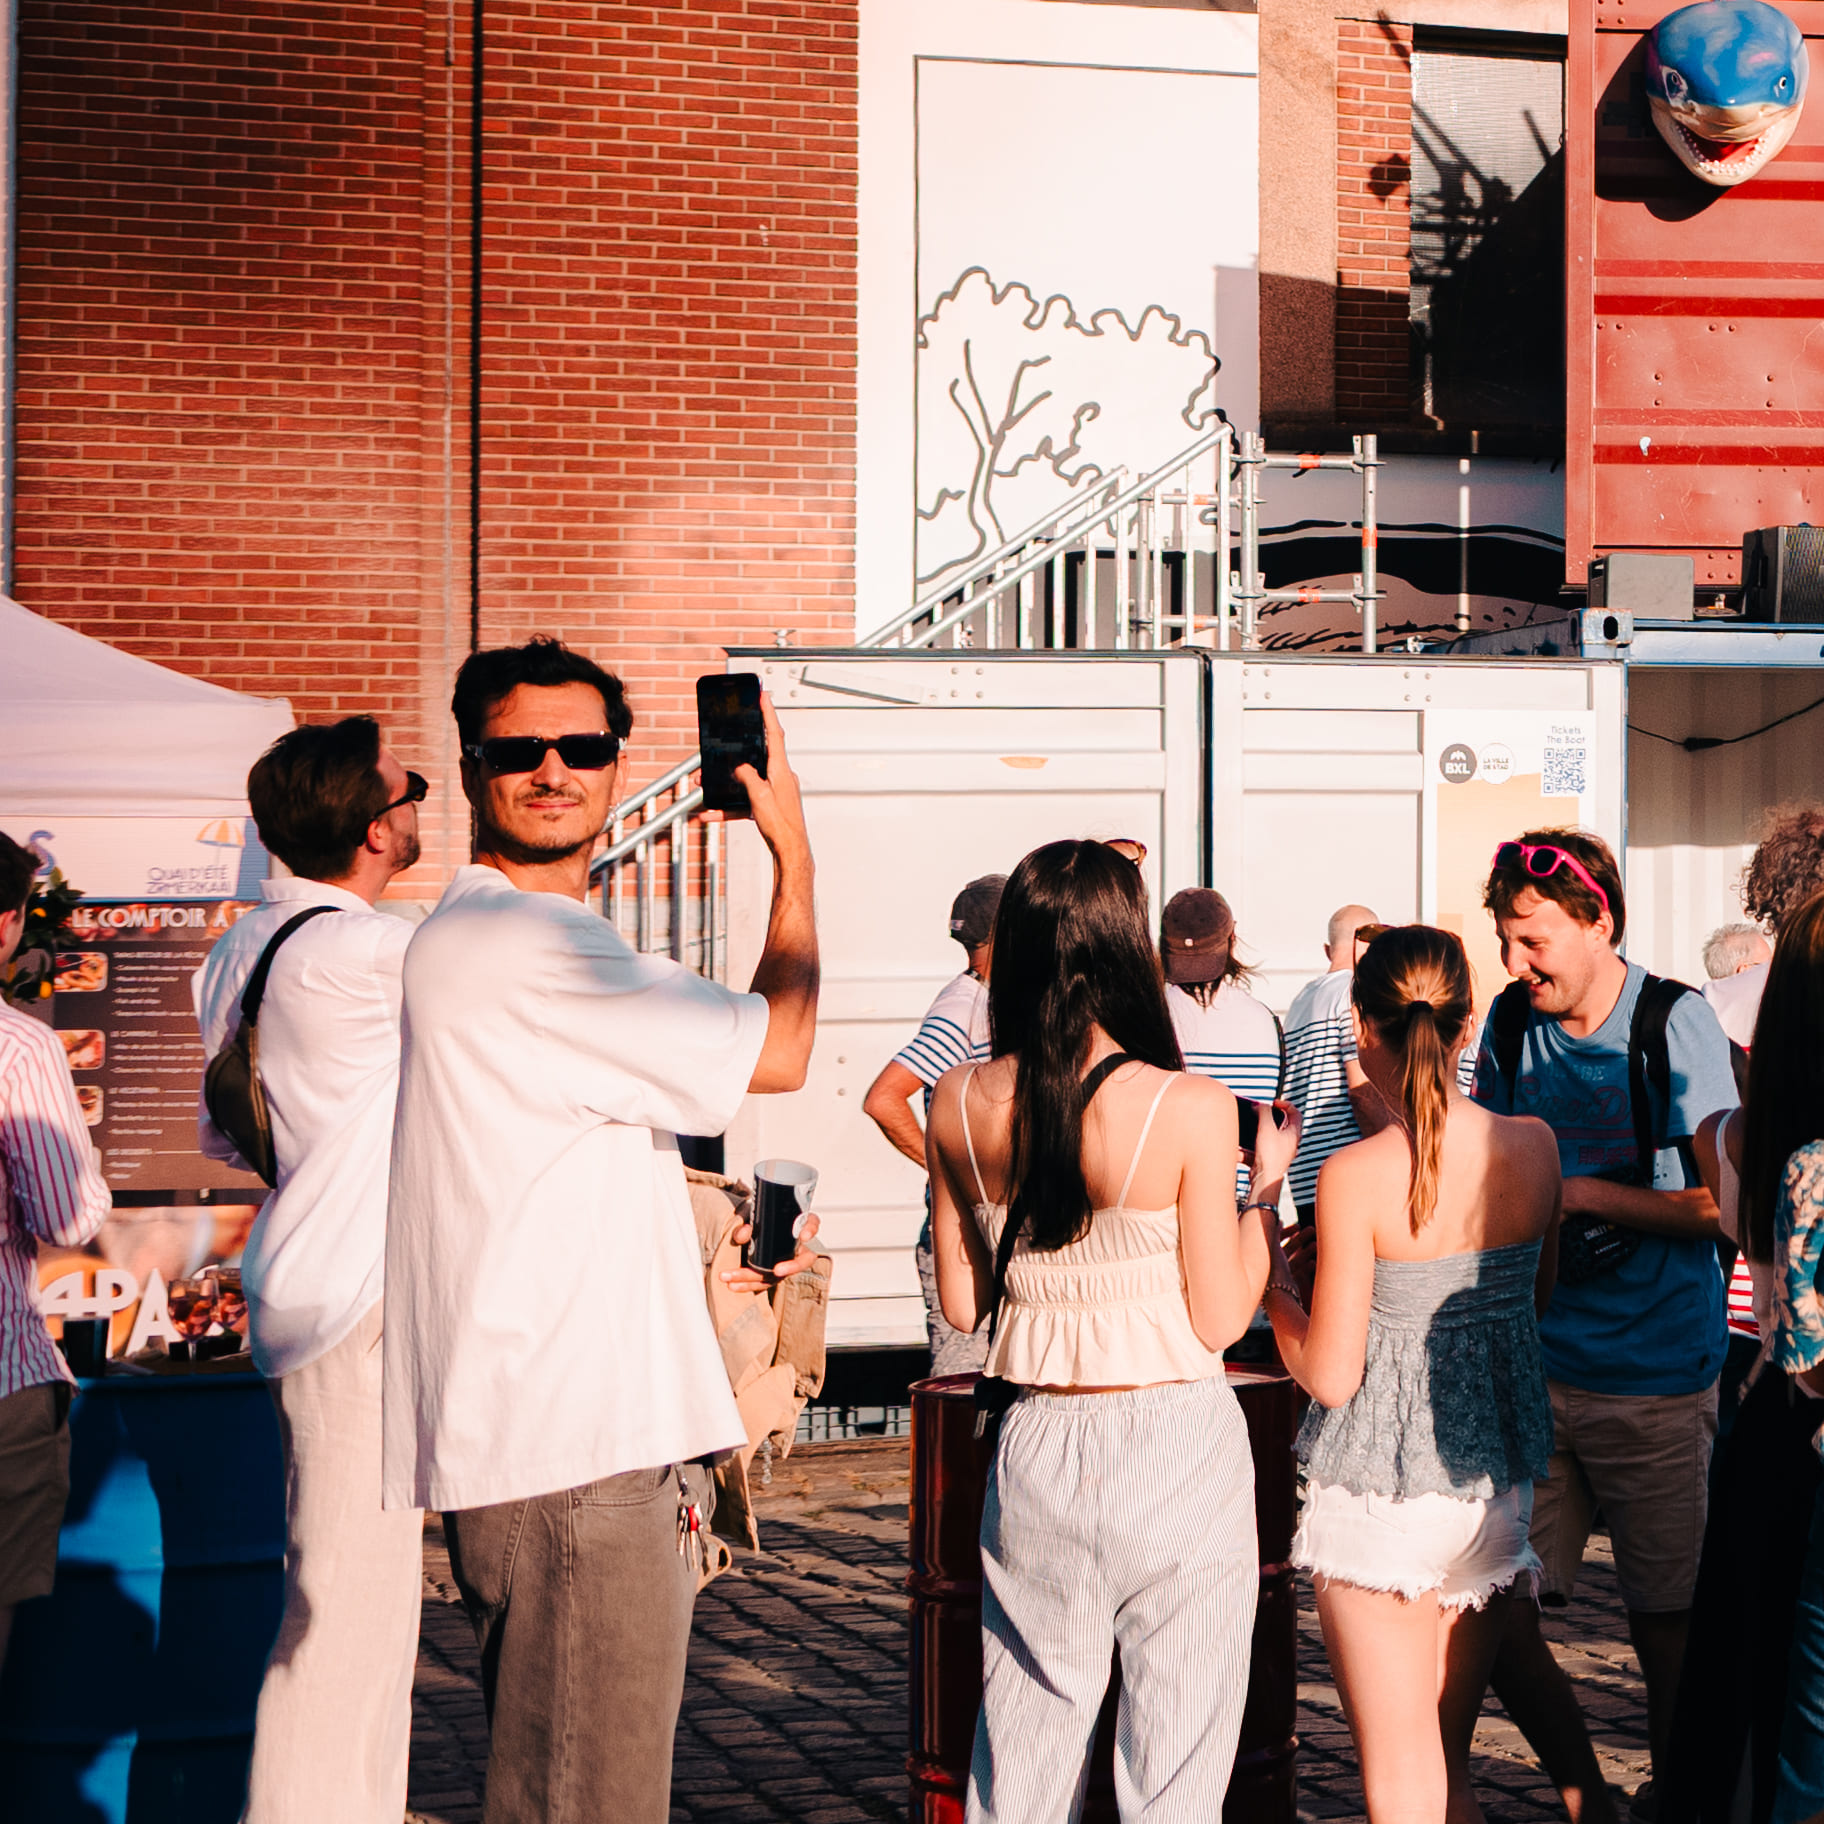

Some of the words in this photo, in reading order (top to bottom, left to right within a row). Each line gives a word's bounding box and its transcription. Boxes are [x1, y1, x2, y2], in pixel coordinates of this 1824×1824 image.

[1551, 725, 1582, 734] Tickets
[1547, 735, 1562, 744] The
[1445, 762, 1471, 775] BXL
[99, 907, 207, 928] COMPTOIR
